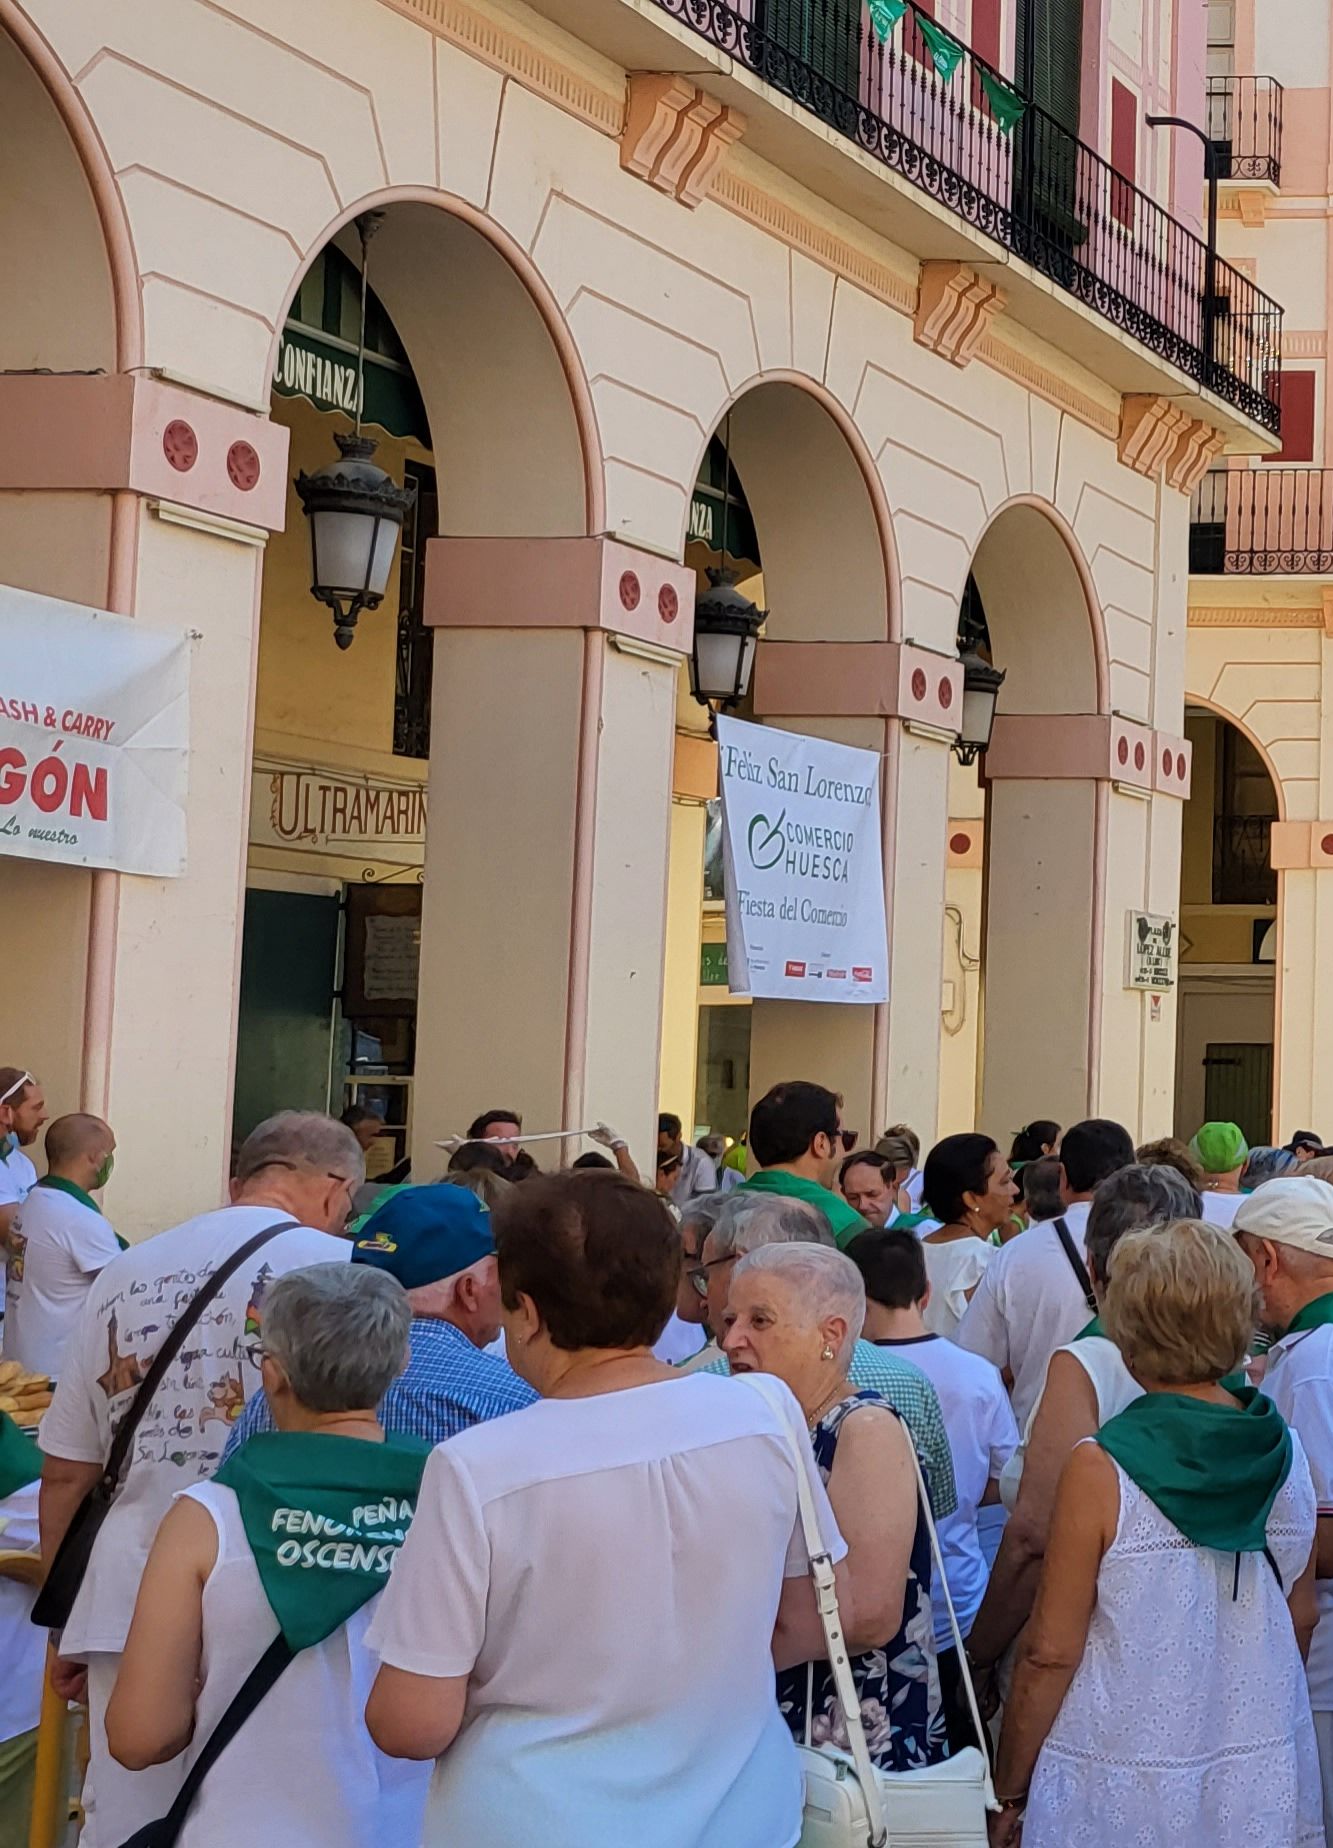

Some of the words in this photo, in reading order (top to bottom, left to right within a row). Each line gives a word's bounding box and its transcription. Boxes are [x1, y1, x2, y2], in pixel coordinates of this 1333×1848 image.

[273, 334, 363, 414] CONFIANZA
[43, 706, 57, 729] &
[61, 710, 115, 742] CARRY
[0, 739, 108, 822] GÓN
[767, 757, 798, 792] San
[28, 824, 79, 846] nuestro
[786, 822, 854, 853] COMERCIO
[785, 849, 849, 883] HUESCA
[738, 890, 775, 919] Fiesta
[779, 896, 797, 921] del
[801, 898, 848, 928] Comercio
[352, 1496, 413, 1528] PEÑA
